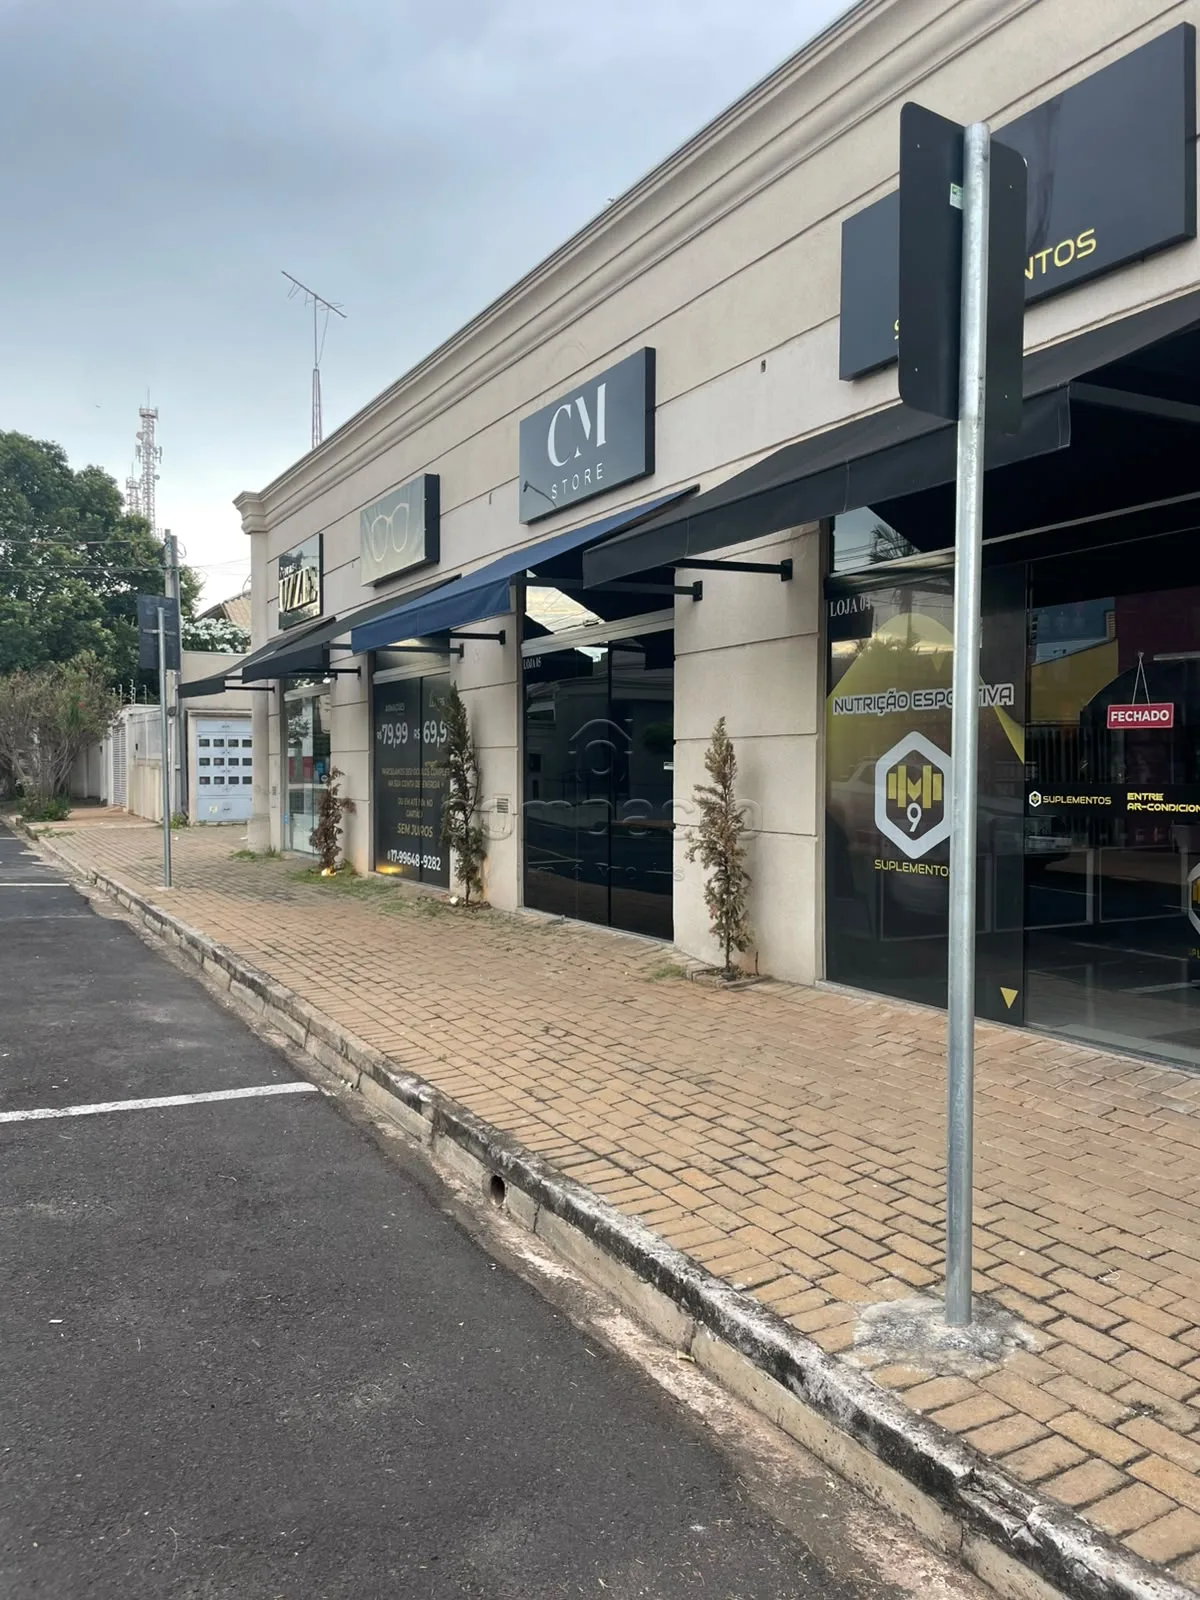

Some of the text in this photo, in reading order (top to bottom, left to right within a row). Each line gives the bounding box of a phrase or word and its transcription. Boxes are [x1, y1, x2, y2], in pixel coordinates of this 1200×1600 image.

[546, 382, 607, 468] CM
[551, 462, 605, 501] STORE
[829, 598, 858, 617] LOJA
[834, 685, 1013, 715] NUTRIÇÃO ESPOIVA
[1110, 708, 1170, 723] FECHADO
[382, 721, 409, 749] 79,99
[422, 719, 448, 749] 69,9
[1042, 795, 1112, 805] SUPLEMENTOS
[1126, 792, 1164, 802] ENTRE
[906, 802, 922, 833] 9
[874, 859, 950, 877] SUPLEMENTO
